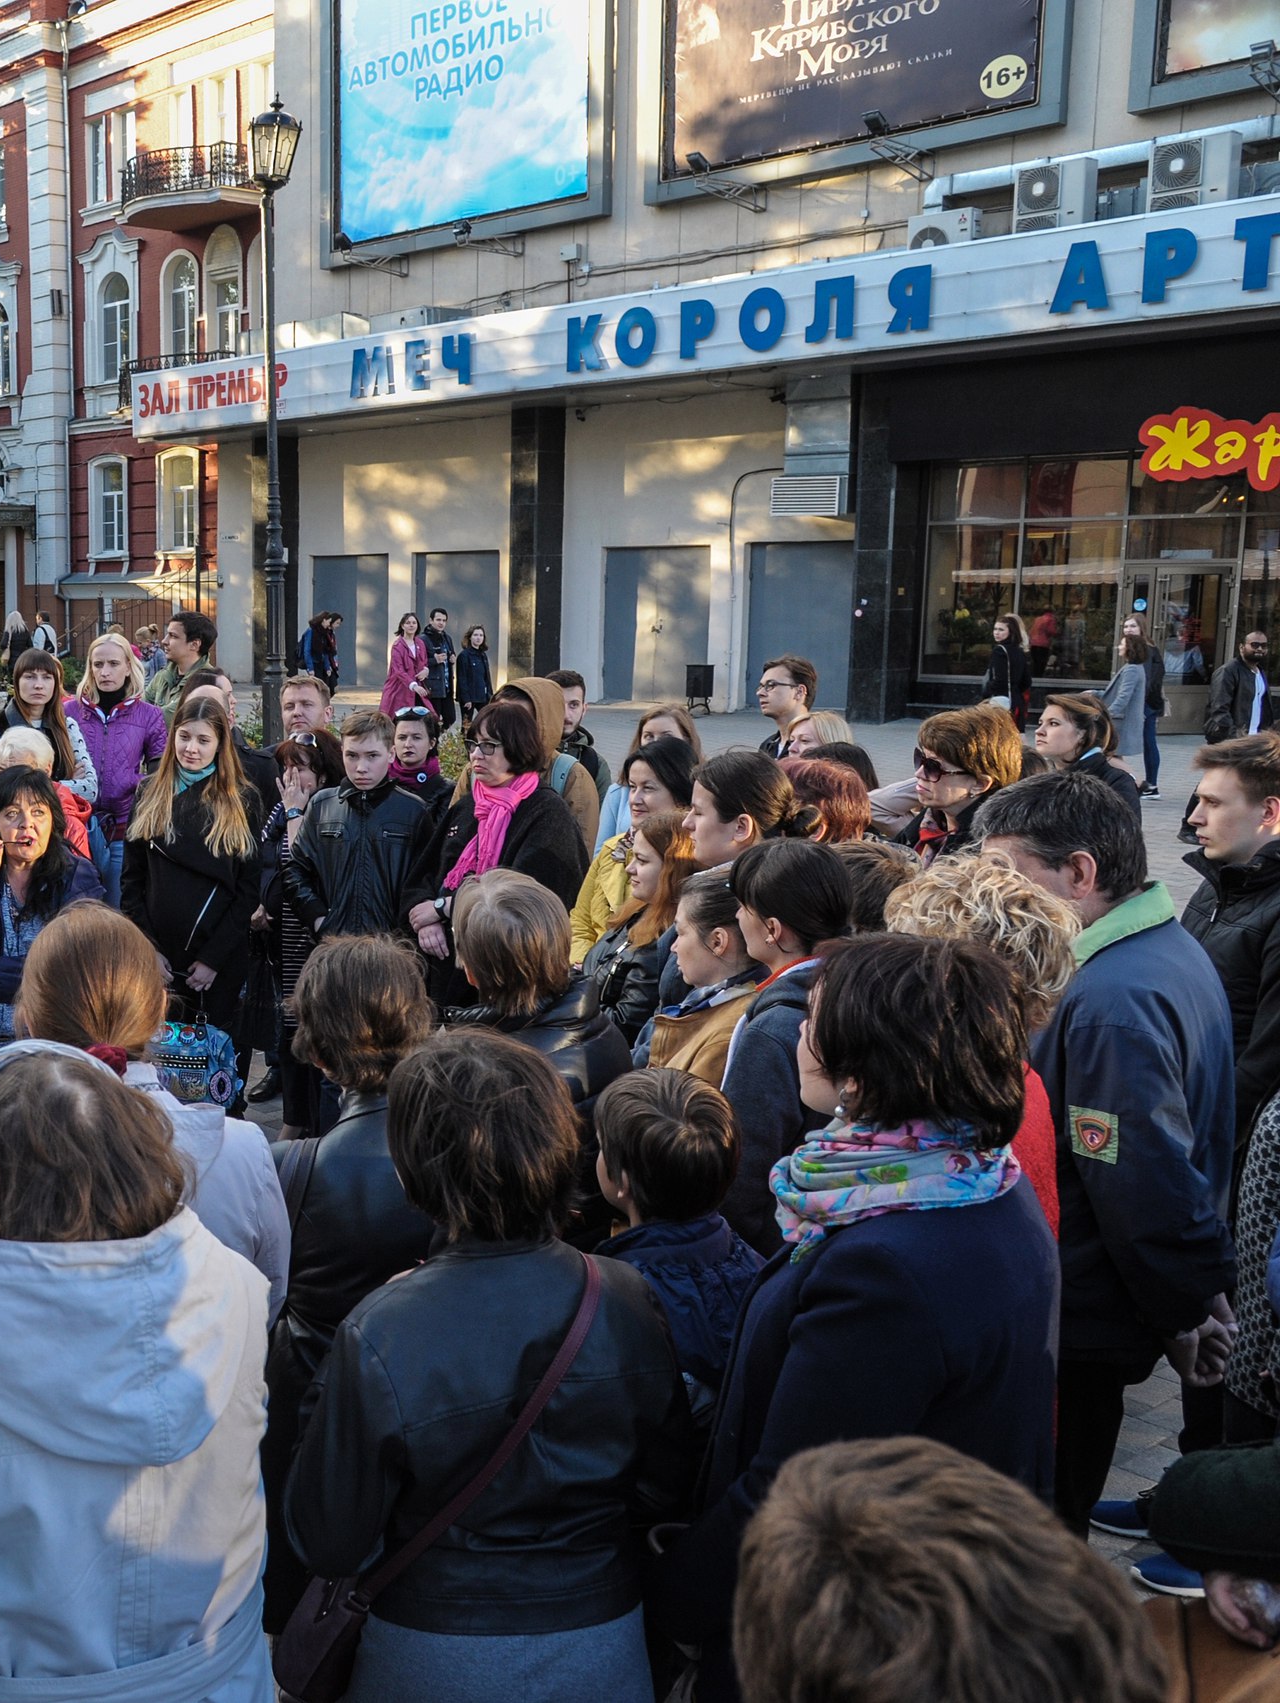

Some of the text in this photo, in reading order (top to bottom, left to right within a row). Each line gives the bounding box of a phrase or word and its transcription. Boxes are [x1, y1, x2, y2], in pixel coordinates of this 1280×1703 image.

[415, 54, 504, 102] РАДИО
[798, 82, 811, 91] НЕ
[816, 60, 902, 87] РАССКАЗЫВАЮТ
[907, 48, 953, 65] СКАЗКИ
[982, 66, 1025, 89] 16+
[554, 164, 580, 186] 0+
[350, 213, 1280, 399] МЕЧ КОРОЛЯ АРТ
[138, 379, 180, 419] ЗАЛ
